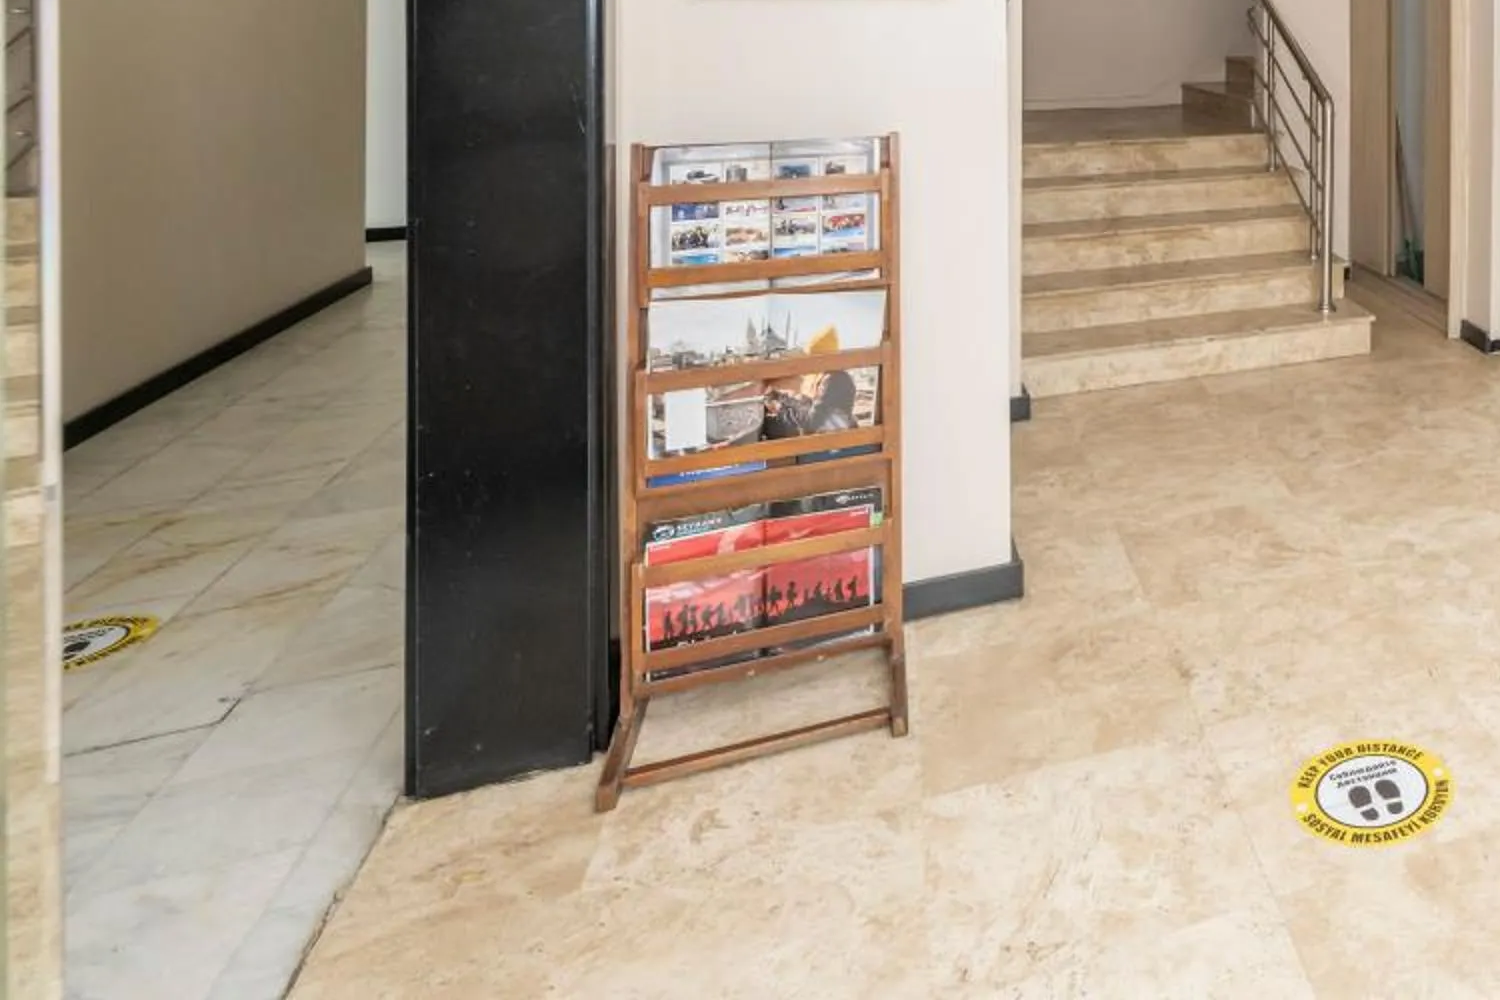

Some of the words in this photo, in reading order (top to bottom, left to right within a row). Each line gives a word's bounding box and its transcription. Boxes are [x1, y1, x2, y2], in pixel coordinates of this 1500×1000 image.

[1319, 747, 1354, 767] YOUR
[1357, 743, 1425, 761] DISTANCE
[1302, 813, 1347, 841] SOSYAL
